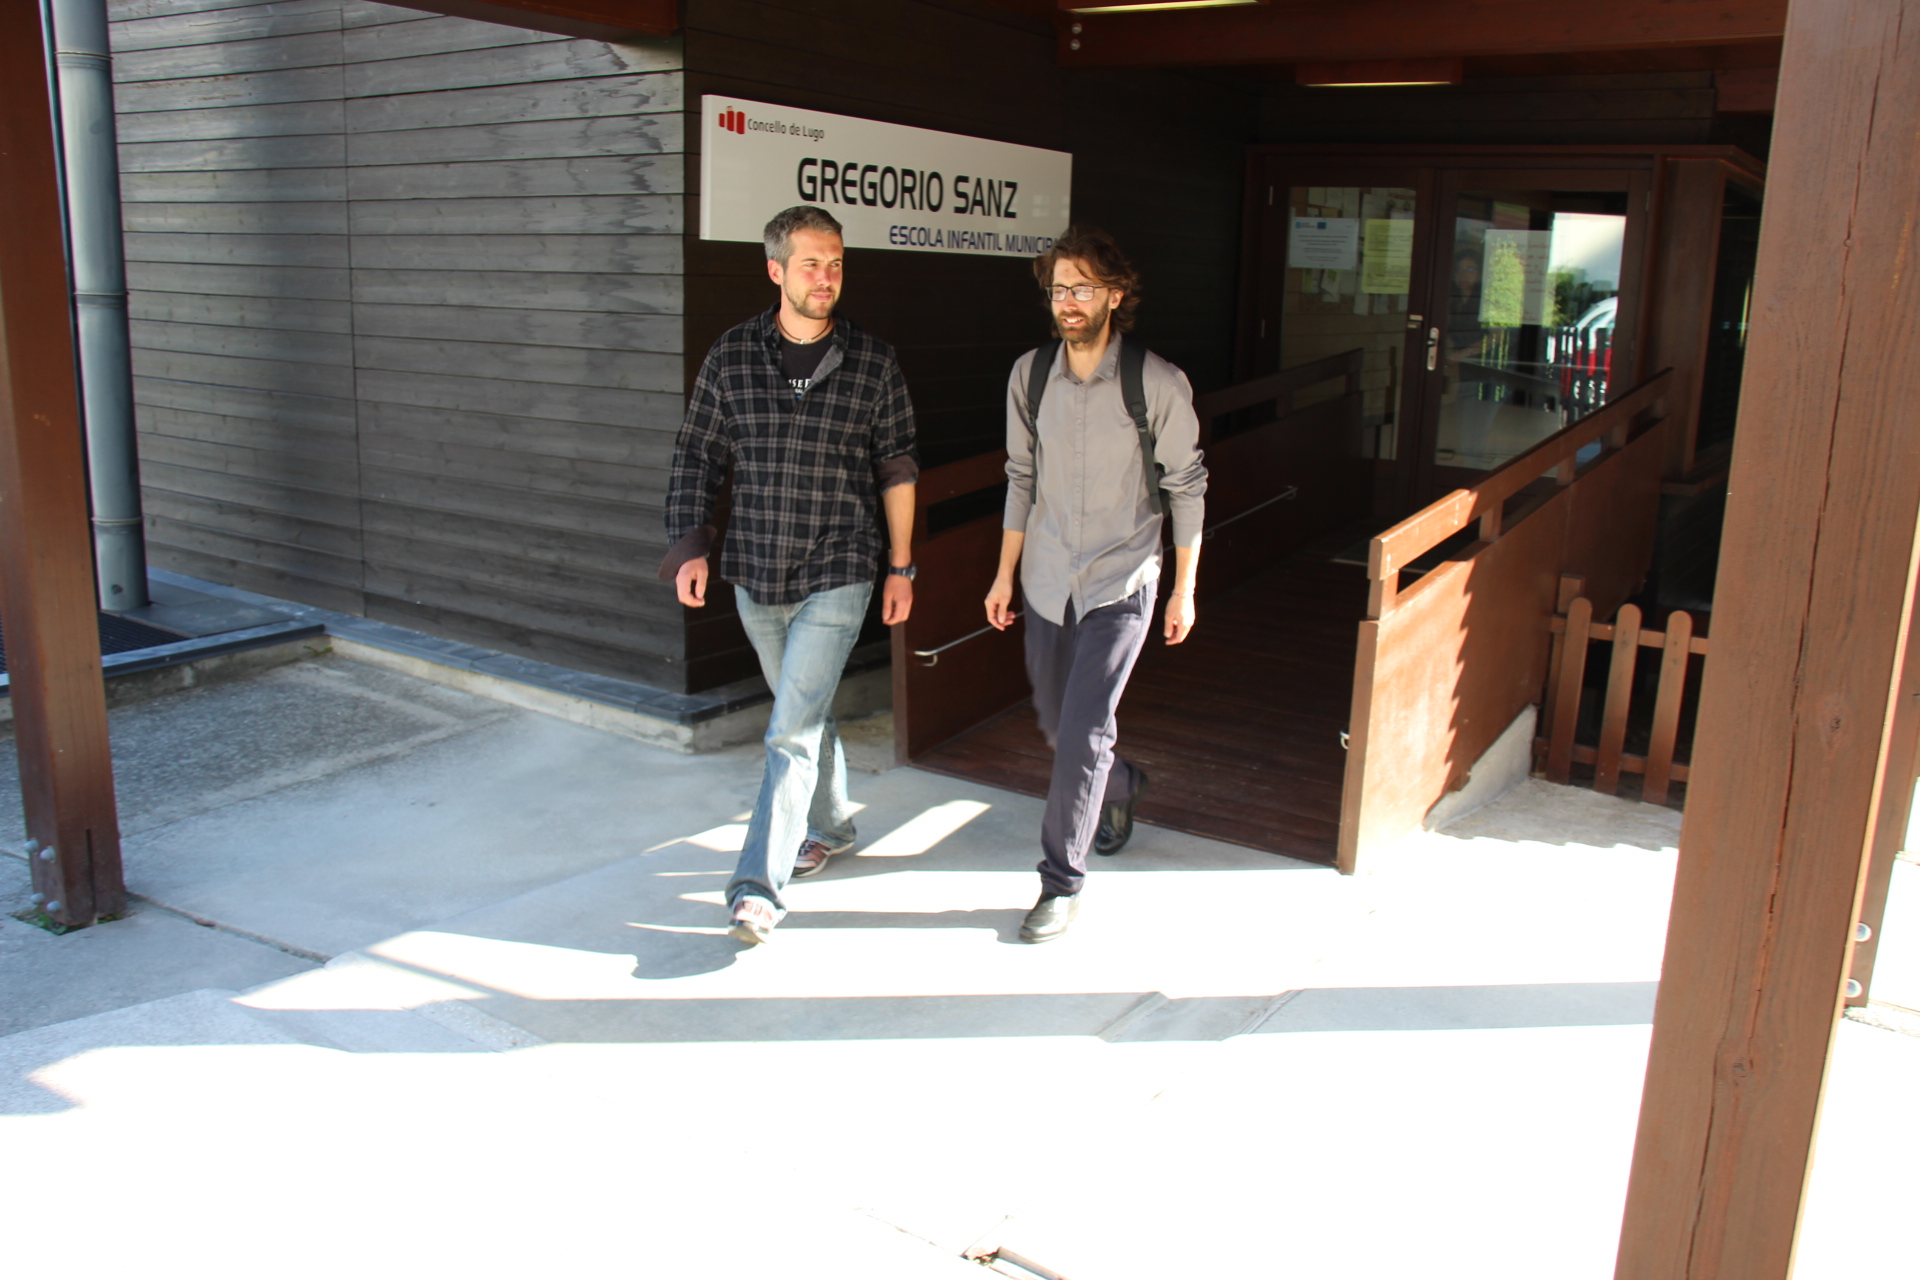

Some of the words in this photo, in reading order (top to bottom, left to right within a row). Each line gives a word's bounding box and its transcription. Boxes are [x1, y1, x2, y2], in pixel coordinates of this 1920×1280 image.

[747, 118, 786, 133] Concello
[789, 122, 801, 136] de
[803, 125, 825, 142] Lugo
[797, 157, 943, 212] GREGORIO
[954, 175, 1018, 218] SANZ
[888, 224, 943, 247] ESCOLA
[947, 230, 1003, 252] INFANTIL
[1005, 234, 1060, 253] MUNICIP
